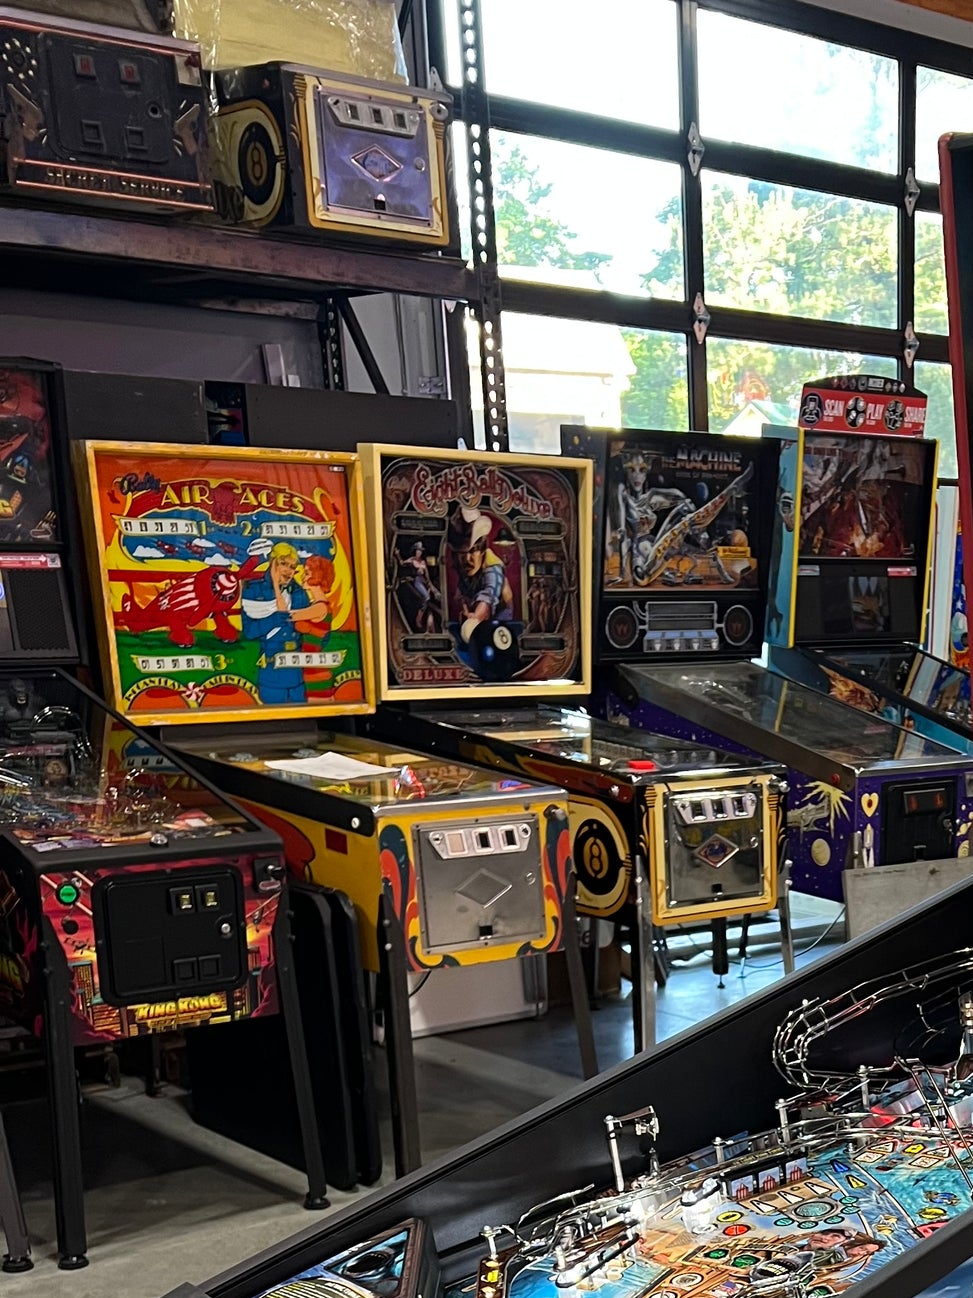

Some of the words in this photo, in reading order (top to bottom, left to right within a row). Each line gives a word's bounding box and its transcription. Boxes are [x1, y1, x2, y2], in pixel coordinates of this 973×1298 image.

[823, 399, 845, 417] SCAN
[866, 403, 884, 420] PLAY
[675, 448, 742, 472] MACHINE
[161, 485, 213, 507] AIR
[239, 487, 305, 513] ACES
[411, 462, 462, 518] Eight
[497, 630, 509, 646] 8
[402, 666, 468, 683] DELUXE
[136, 1003, 176, 1021] KING
[178, 995, 221, 1014] KONG
